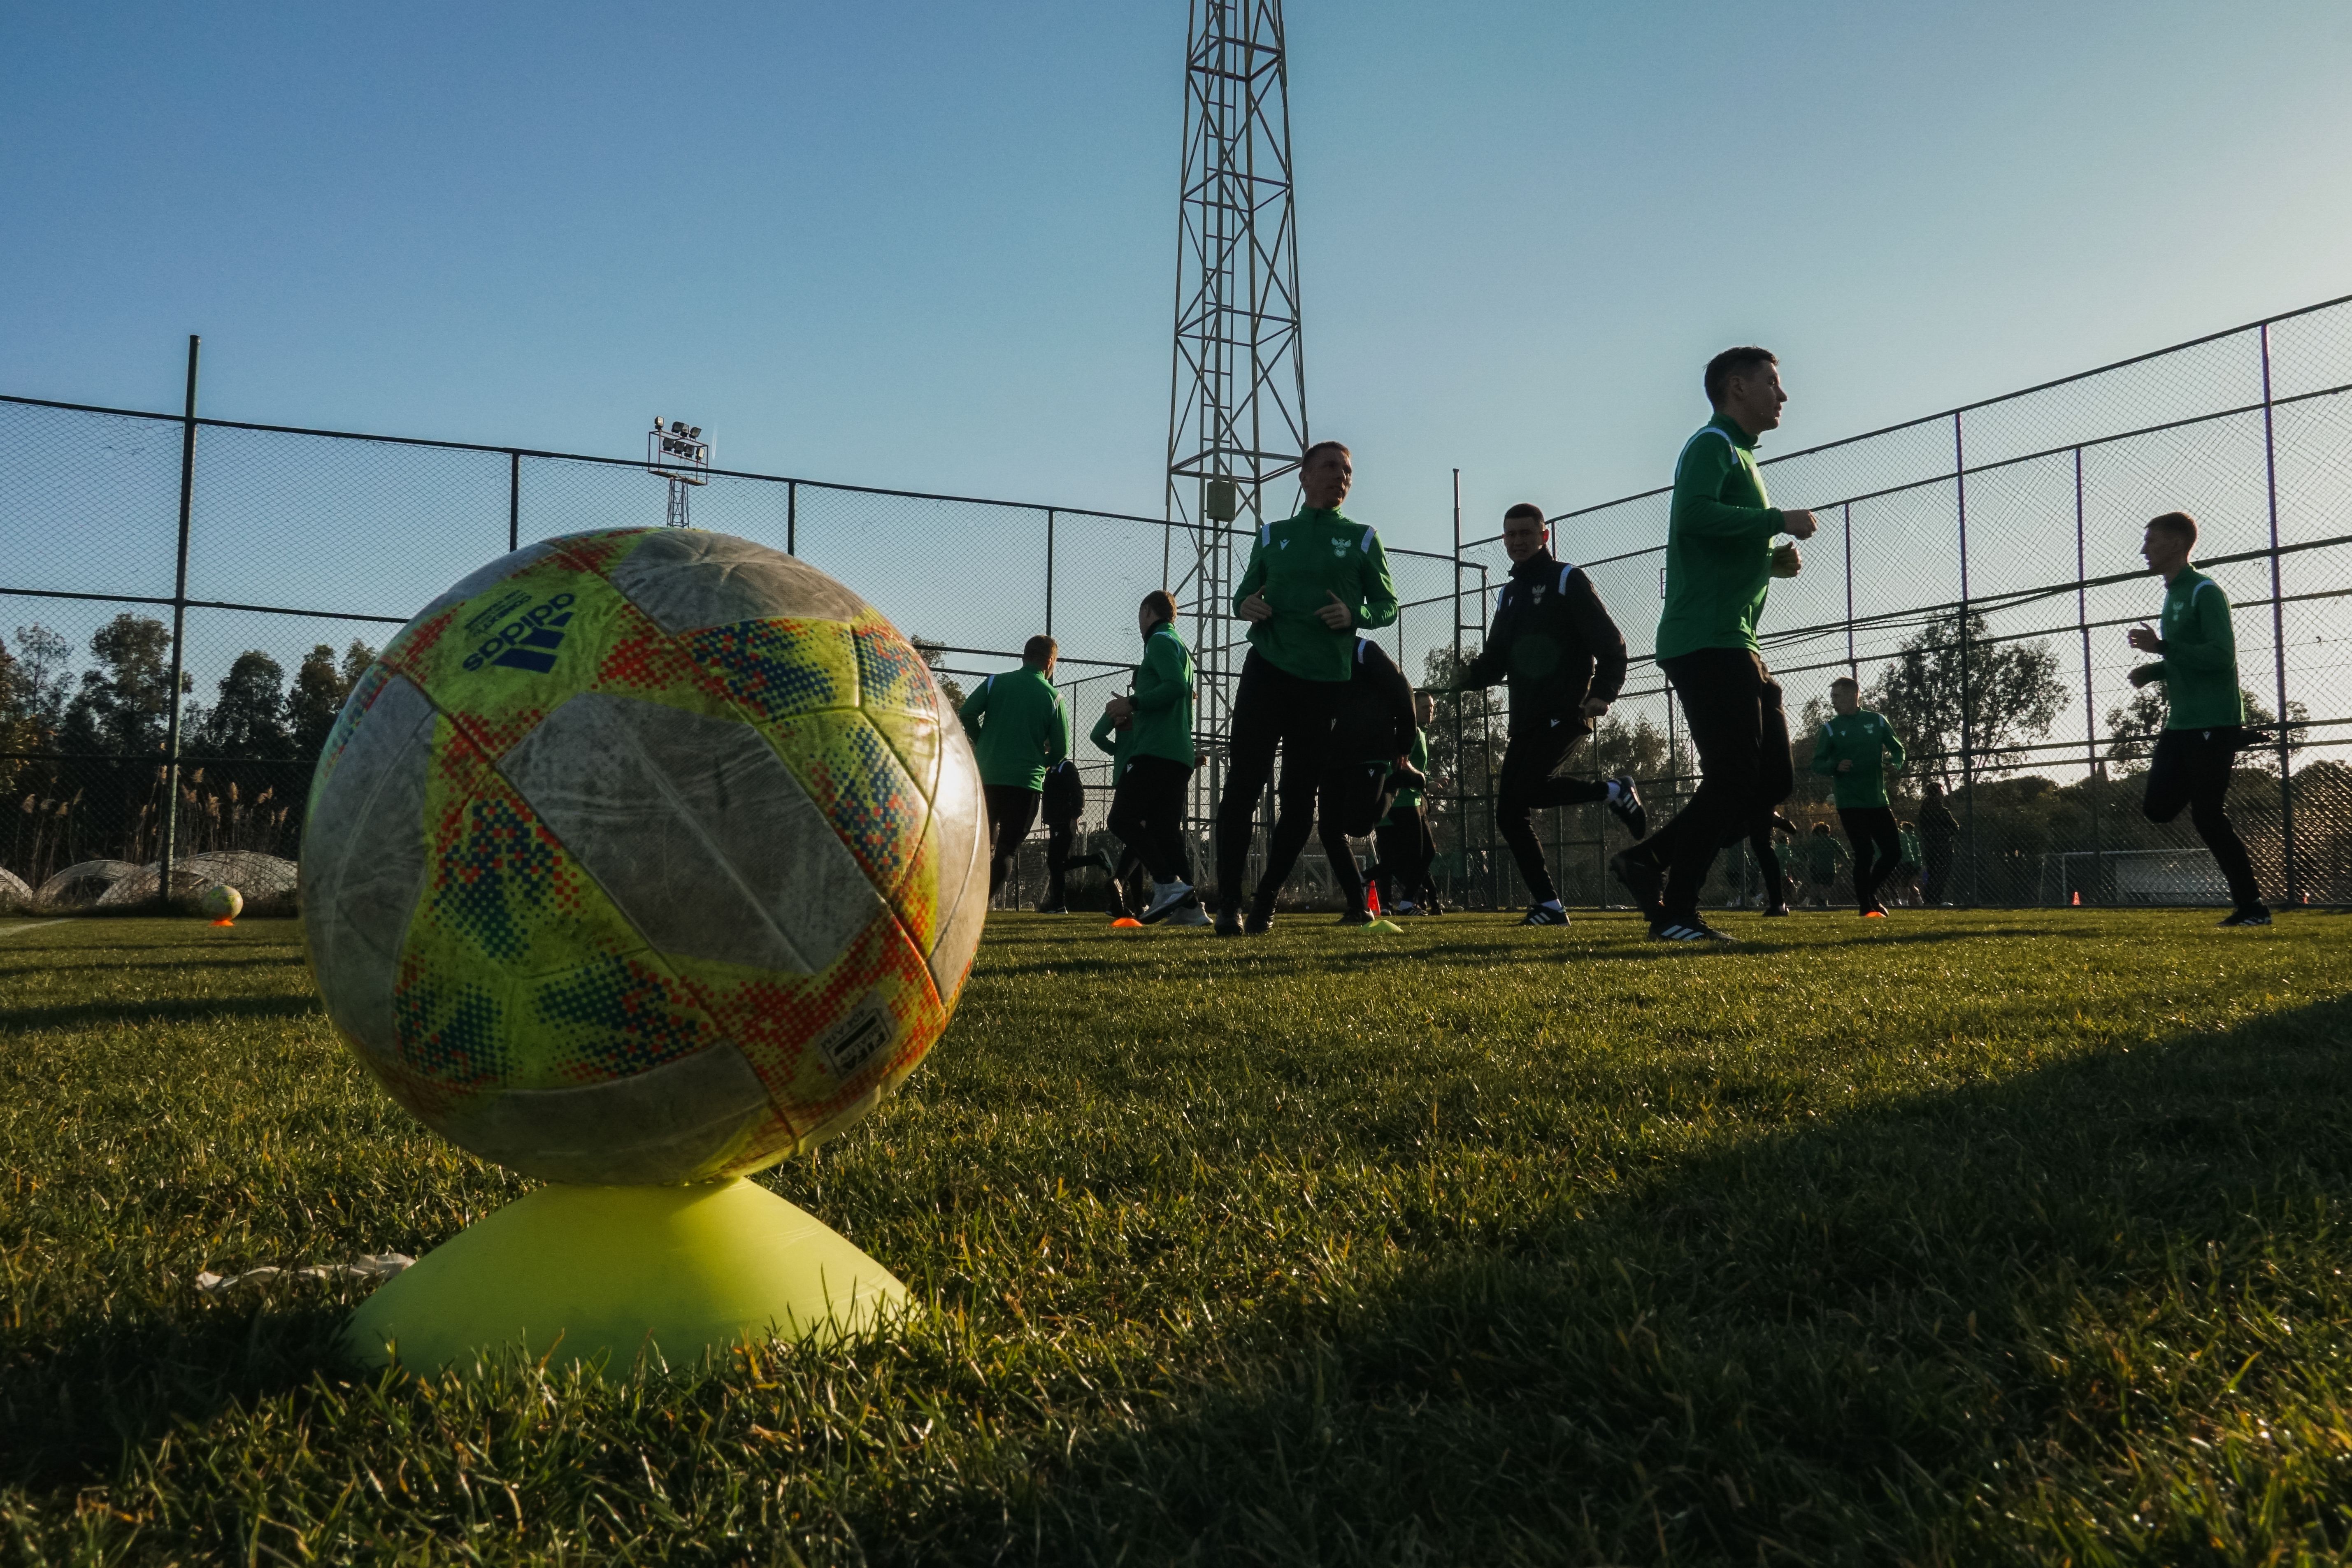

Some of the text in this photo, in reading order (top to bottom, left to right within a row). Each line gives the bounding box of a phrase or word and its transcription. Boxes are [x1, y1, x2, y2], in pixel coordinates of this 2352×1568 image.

[462, 593, 575, 671] adidas
[840, 1024, 881, 1062] QUALITY
[843, 1031, 886, 1070] FIFA
